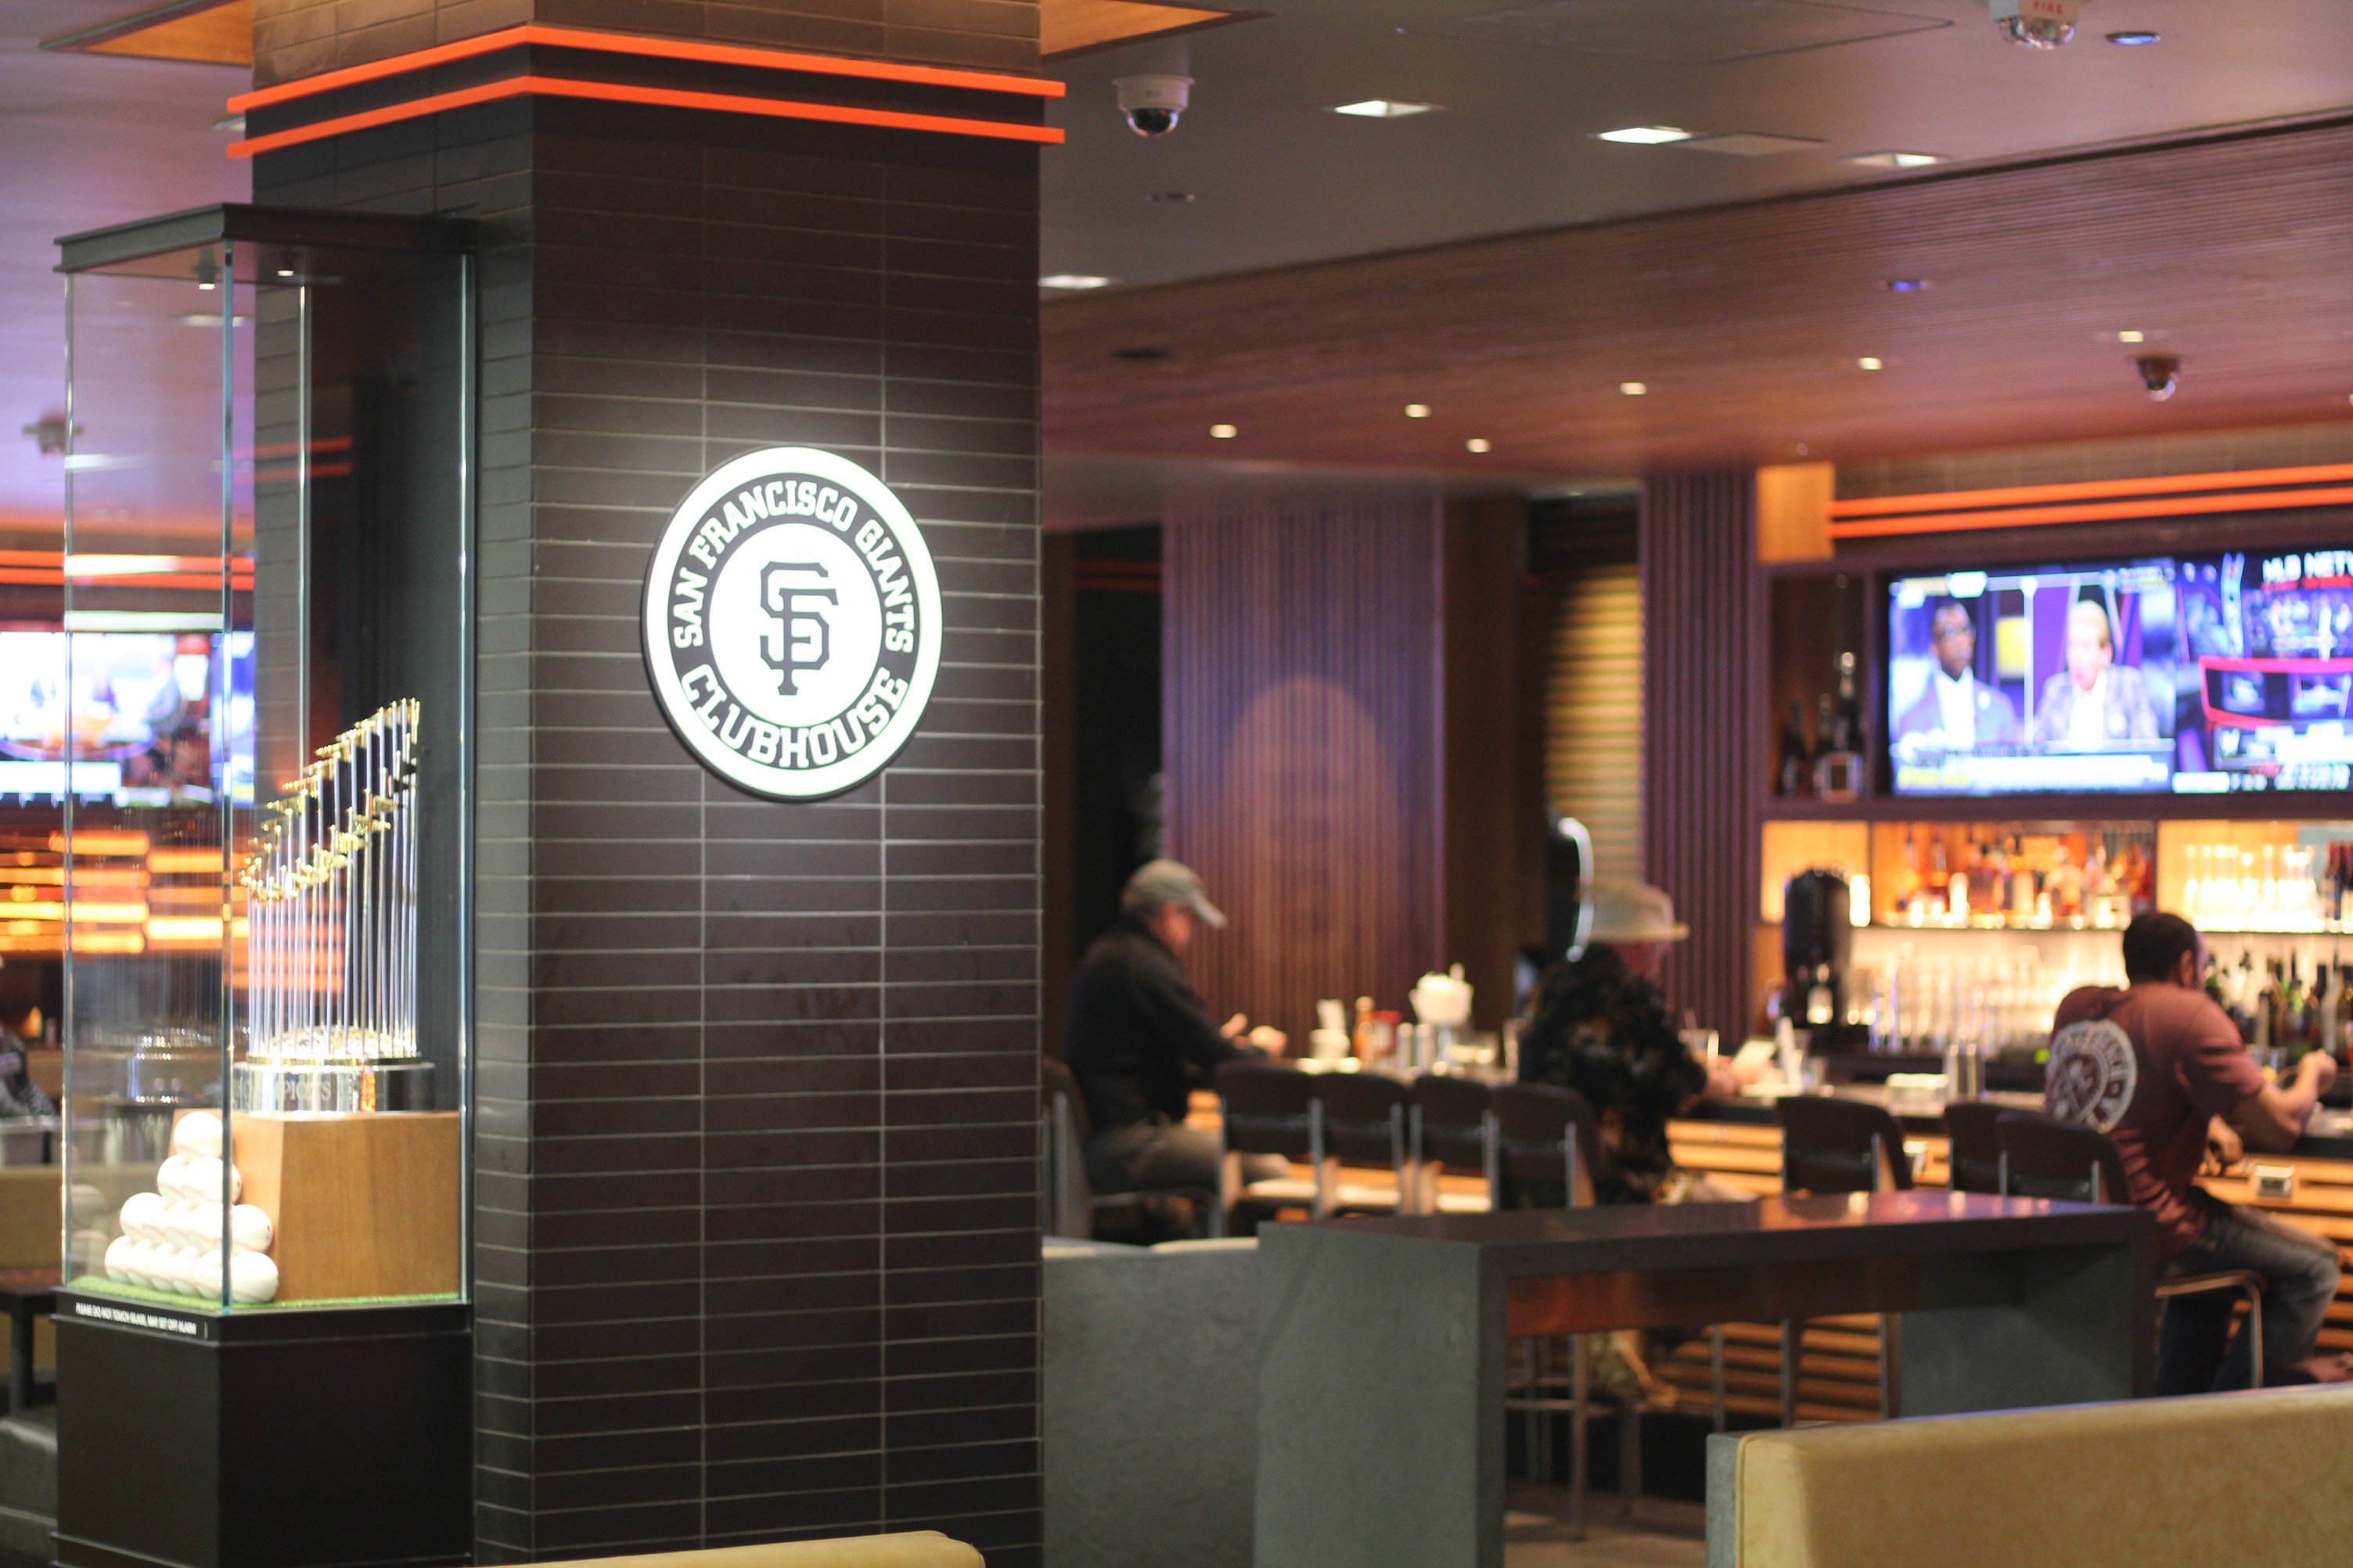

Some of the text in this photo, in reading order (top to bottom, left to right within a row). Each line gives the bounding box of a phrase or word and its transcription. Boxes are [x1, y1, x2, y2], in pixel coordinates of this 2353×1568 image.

[672, 480, 916, 654] SAN FRANCISCO GIANTS
[680, 663, 909, 769] CLUBHOUSE
[92, 1305, 102, 1319] DO
[102, 1306, 113, 1321] NOT
[113, 1308, 130, 1324] TOUCH
[178, 1320, 197, 1335] ALARM
